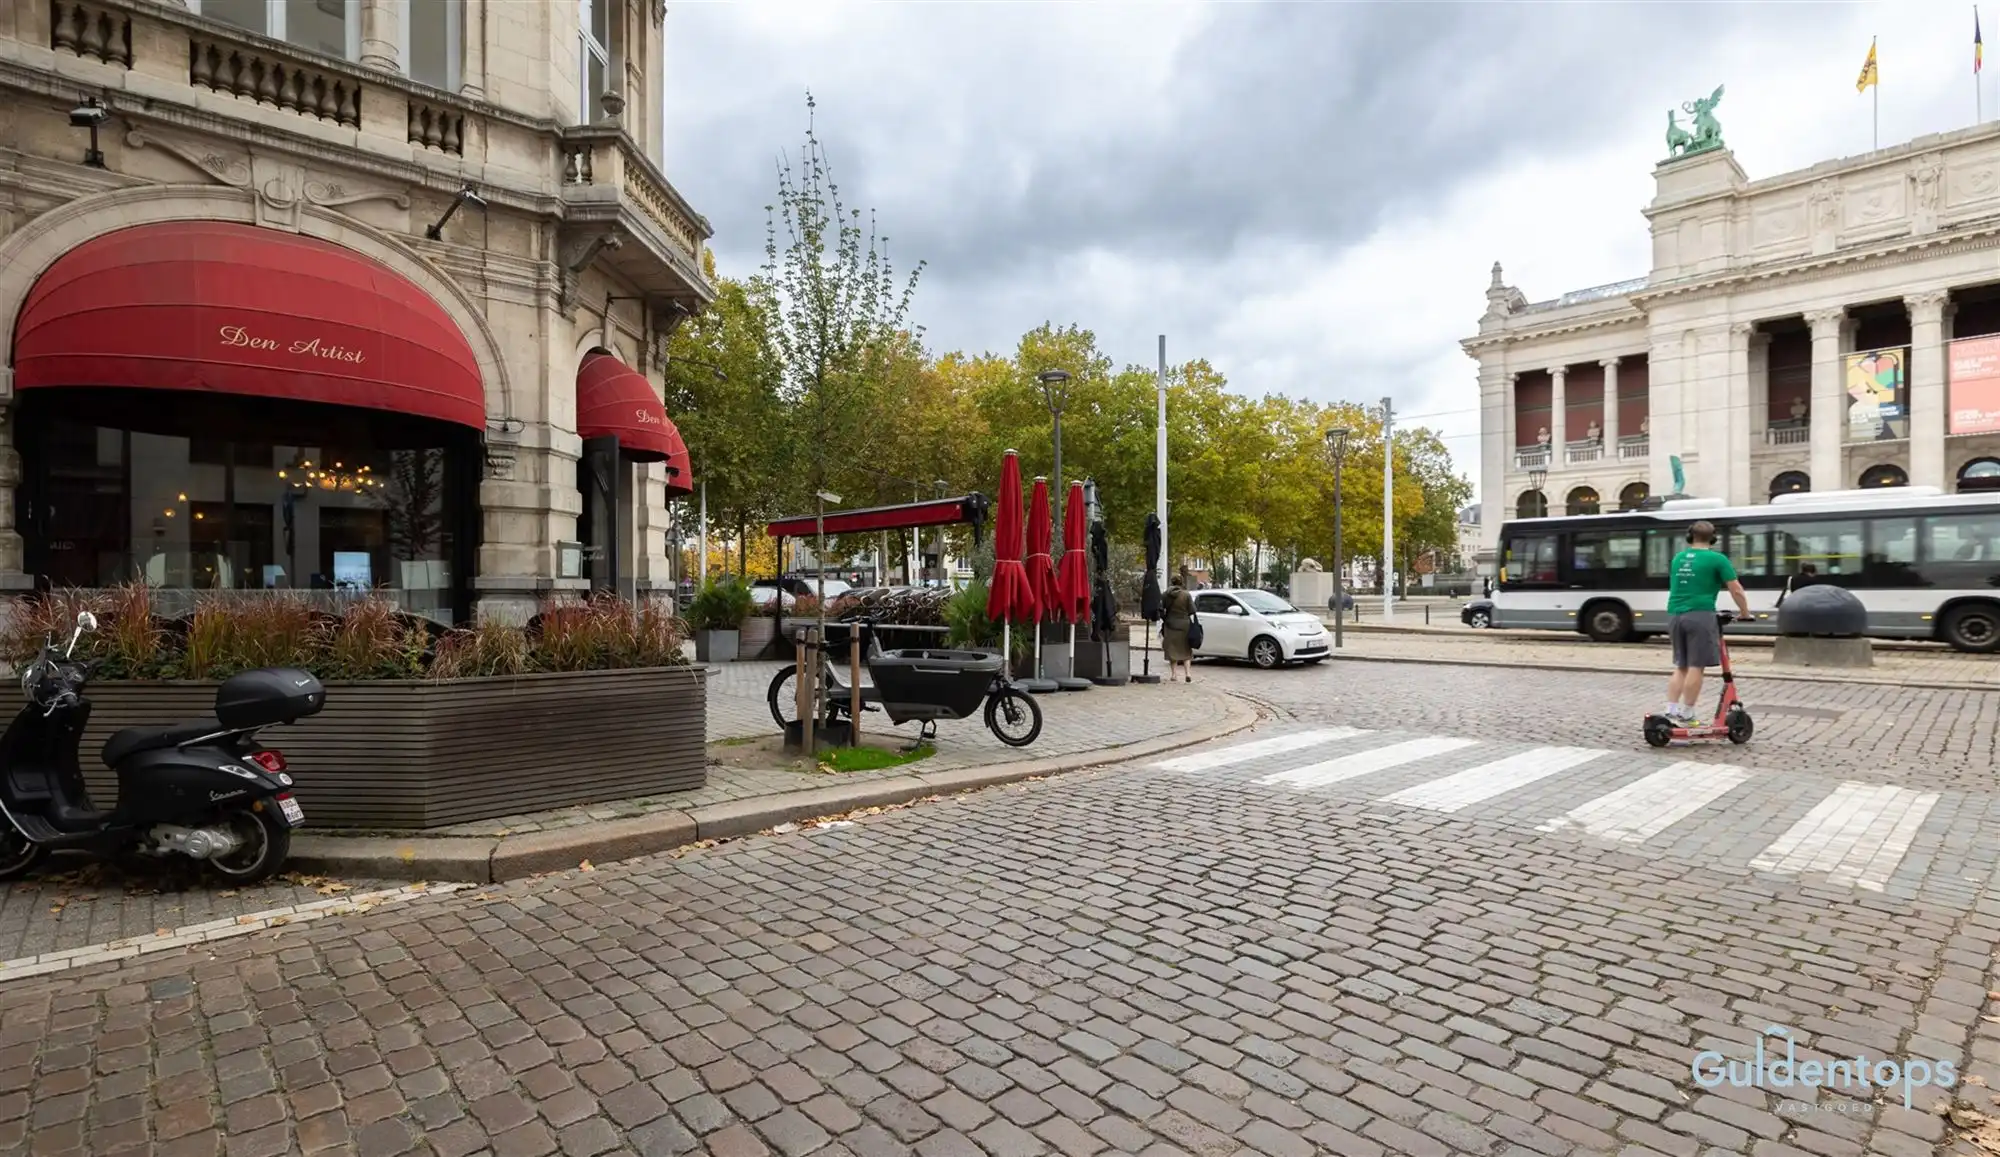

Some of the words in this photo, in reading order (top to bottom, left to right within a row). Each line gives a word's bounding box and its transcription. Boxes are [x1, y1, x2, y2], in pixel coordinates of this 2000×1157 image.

[220, 325, 281, 350] Den
[288, 338, 365, 364] Artist
[635, 408, 660, 424] Den
